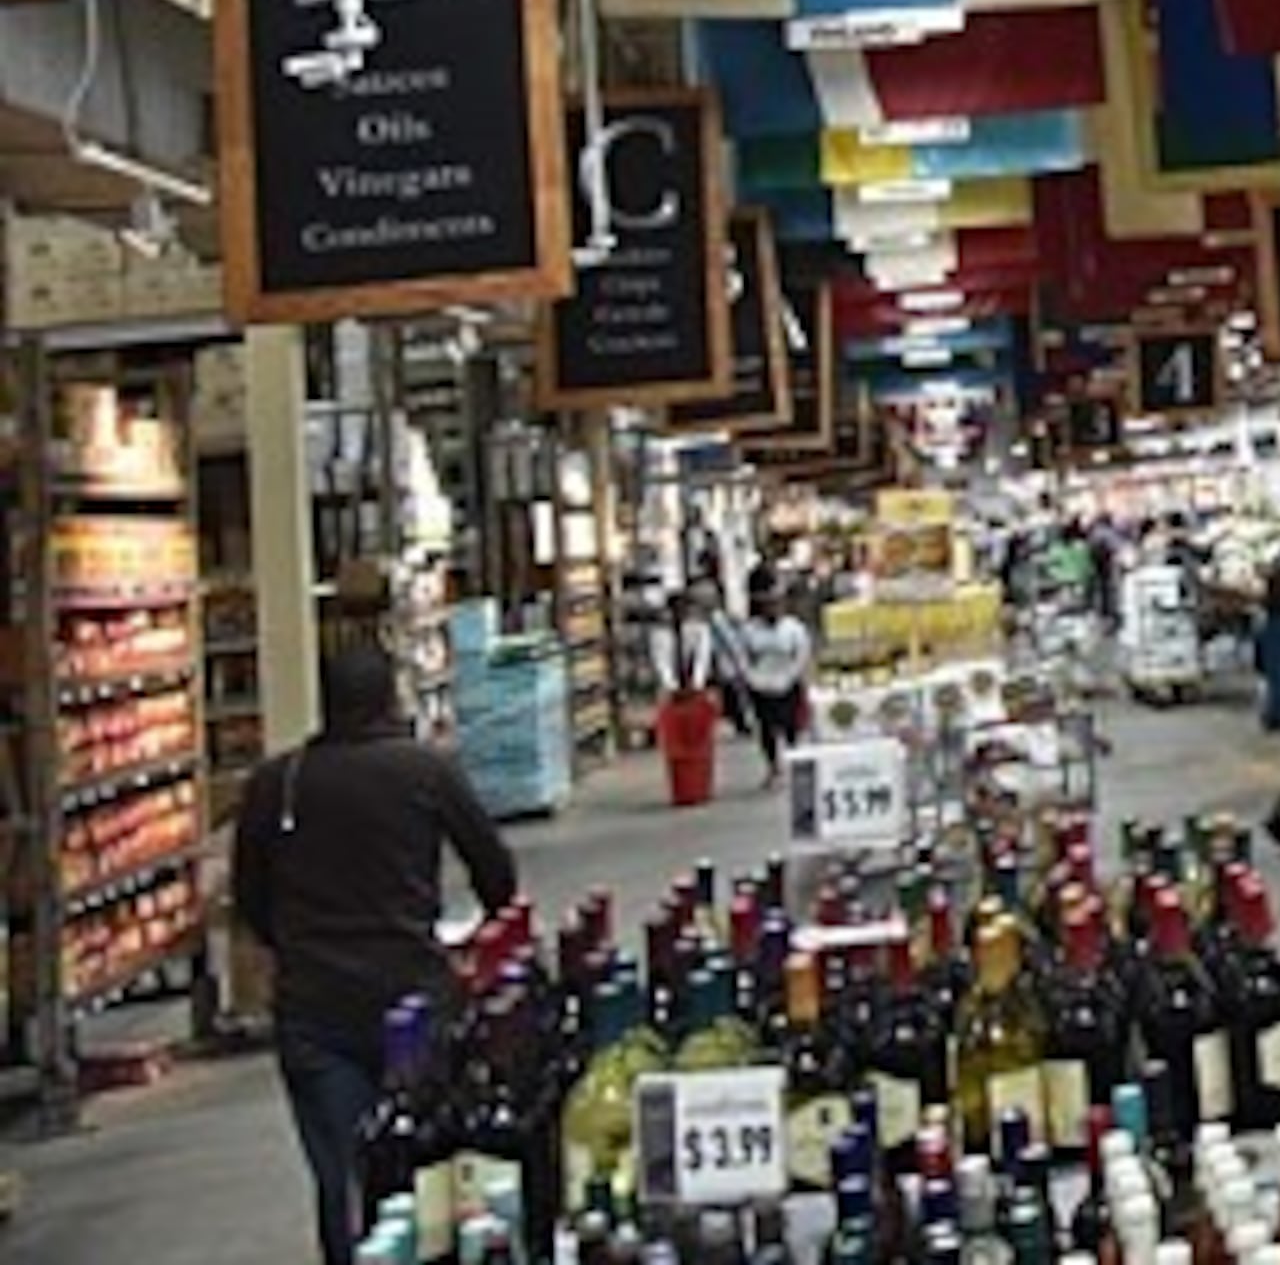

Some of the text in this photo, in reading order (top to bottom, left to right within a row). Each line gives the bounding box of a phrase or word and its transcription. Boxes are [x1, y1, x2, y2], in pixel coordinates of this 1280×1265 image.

[356, 111, 432, 145] Oils
[317, 164, 473, 202] Vinegars
[1155, 342, 1195, 401] 4
